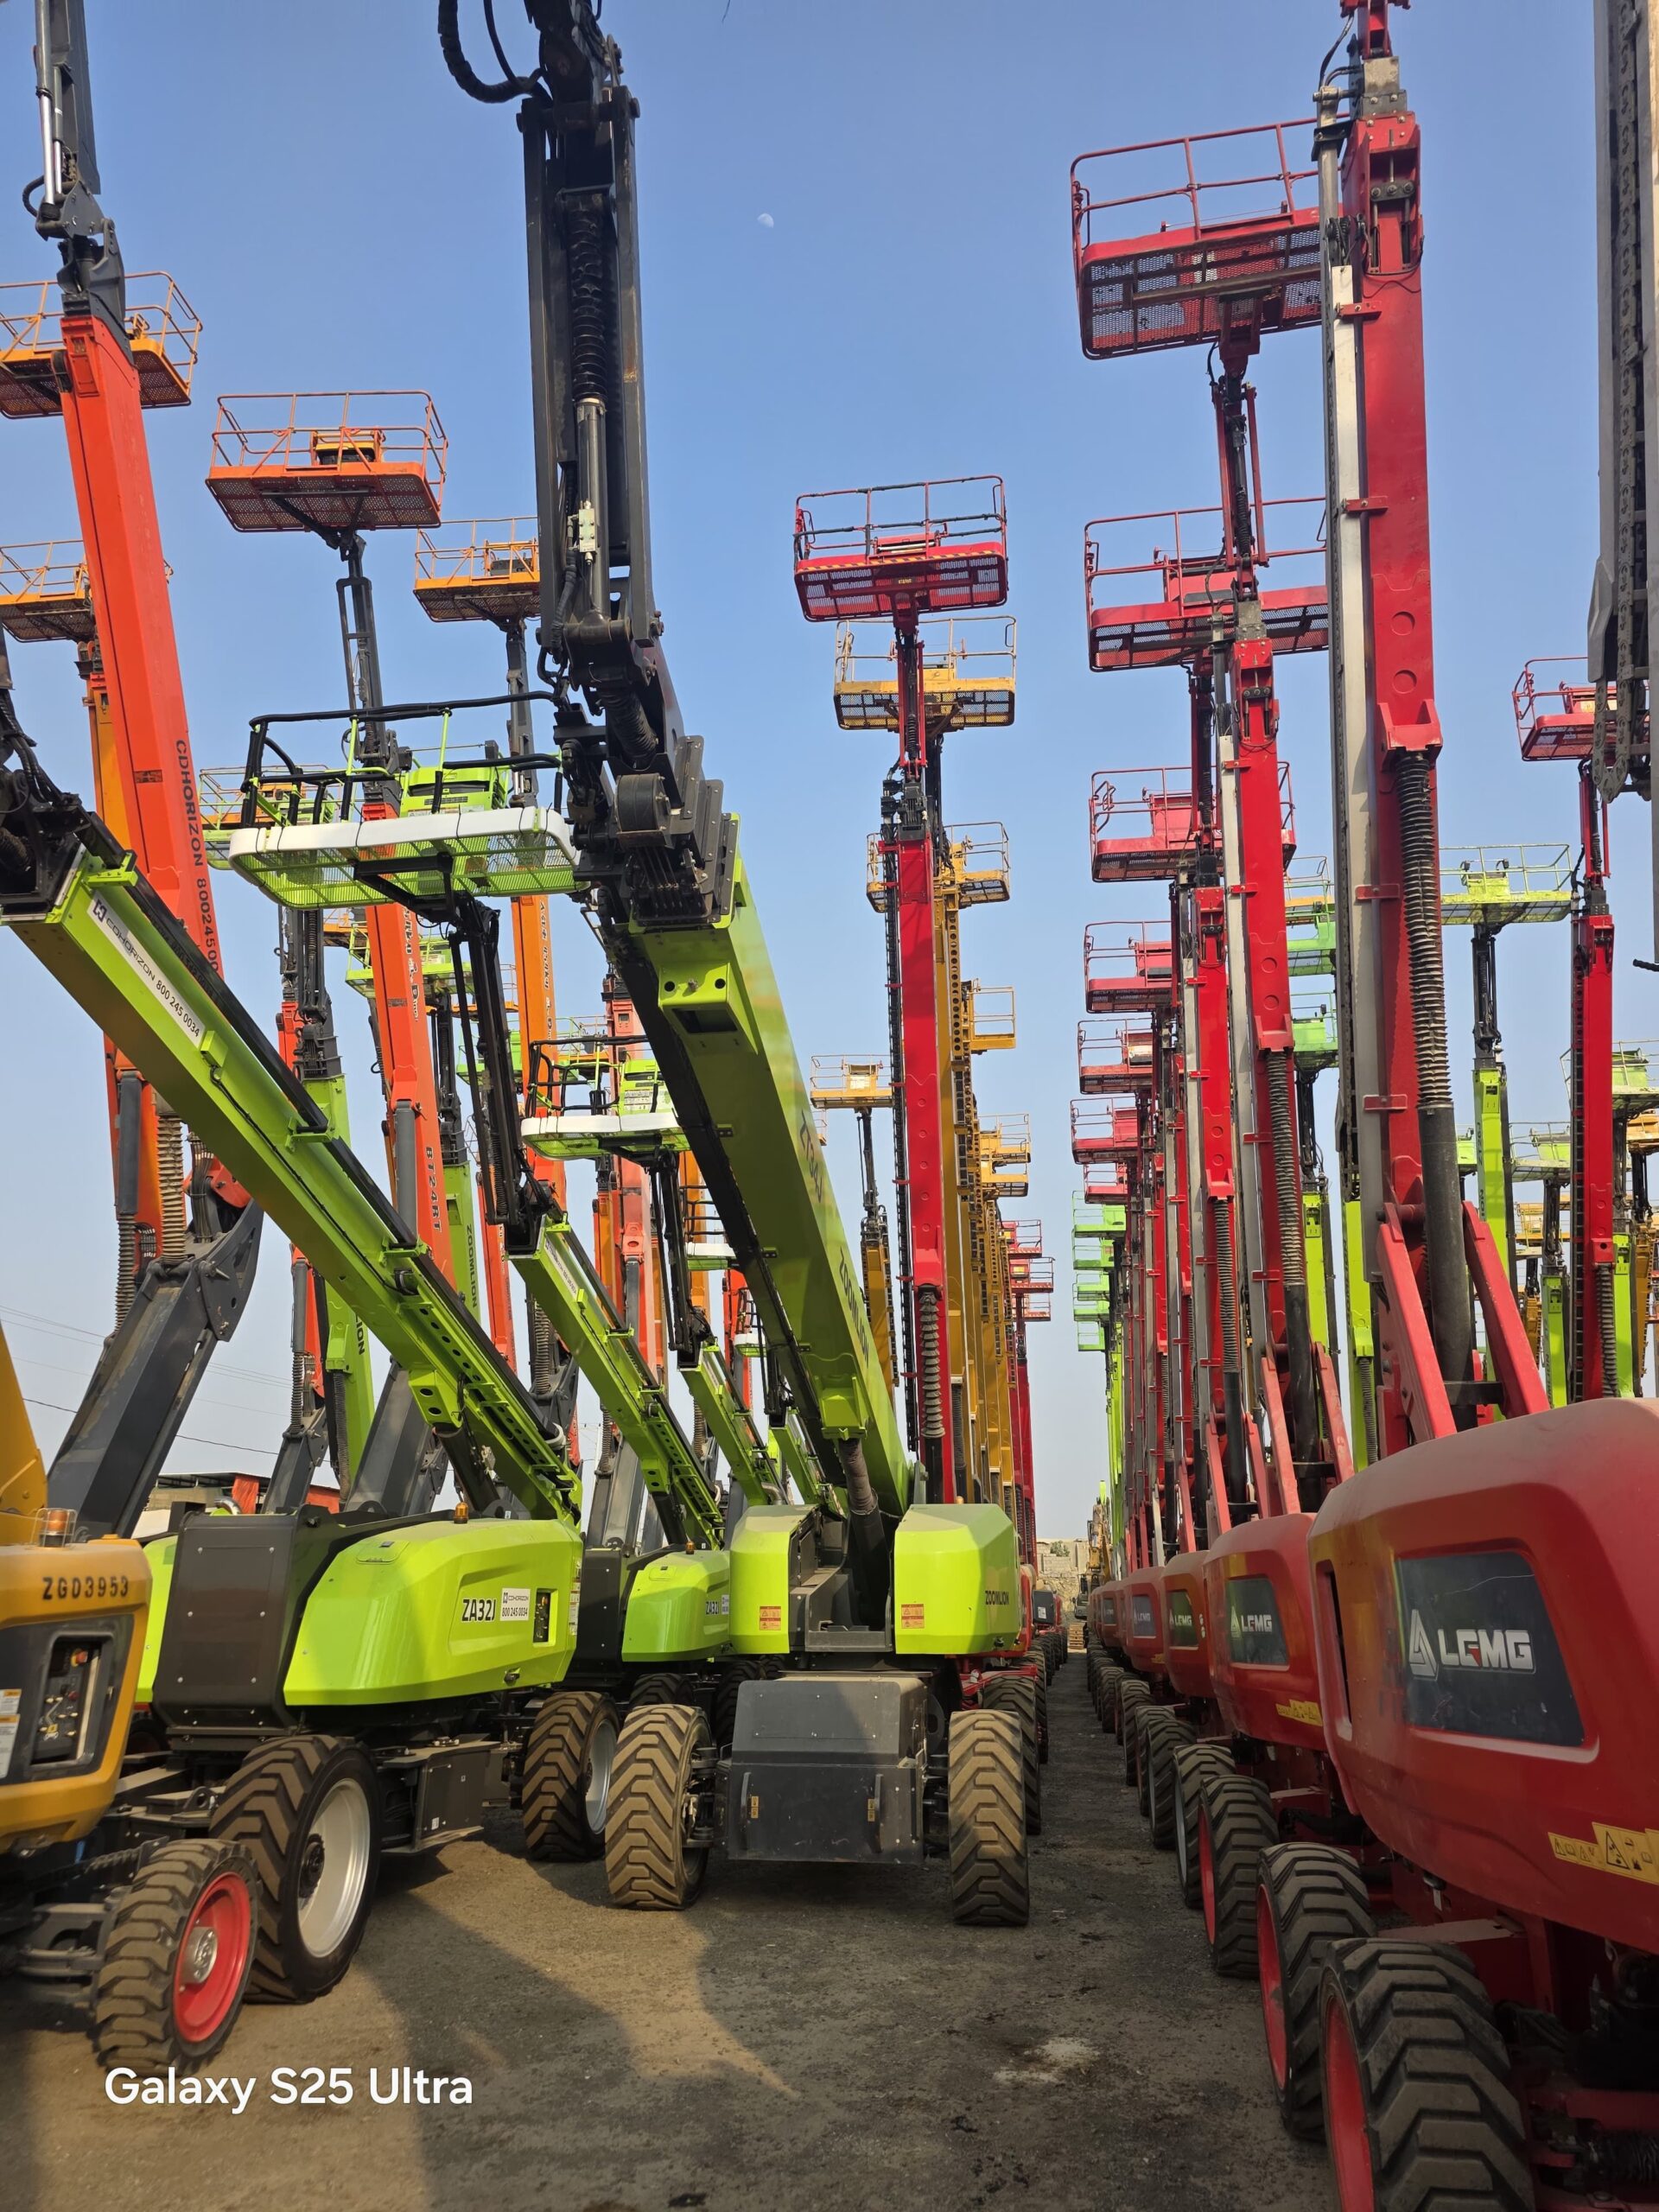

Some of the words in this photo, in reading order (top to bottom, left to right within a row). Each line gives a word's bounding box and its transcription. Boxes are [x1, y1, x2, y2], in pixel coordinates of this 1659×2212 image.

[156, 980, 169, 1000] 800
[169, 996, 183, 1016] 245
[183, 1014, 200, 1037] 0034
[425, 1147, 442, 1233] BT24RT
[466, 1224, 478, 1308] ZOOMLION
[839, 1246, 869, 1369] ZOOMLION
[461, 1599, 496, 1622] ZA32J
[985, 1590, 1009, 1605] ZOOMLION
[1241, 1614, 1273, 1632] LGMG
[1438, 1629, 1534, 1670] LGMG
